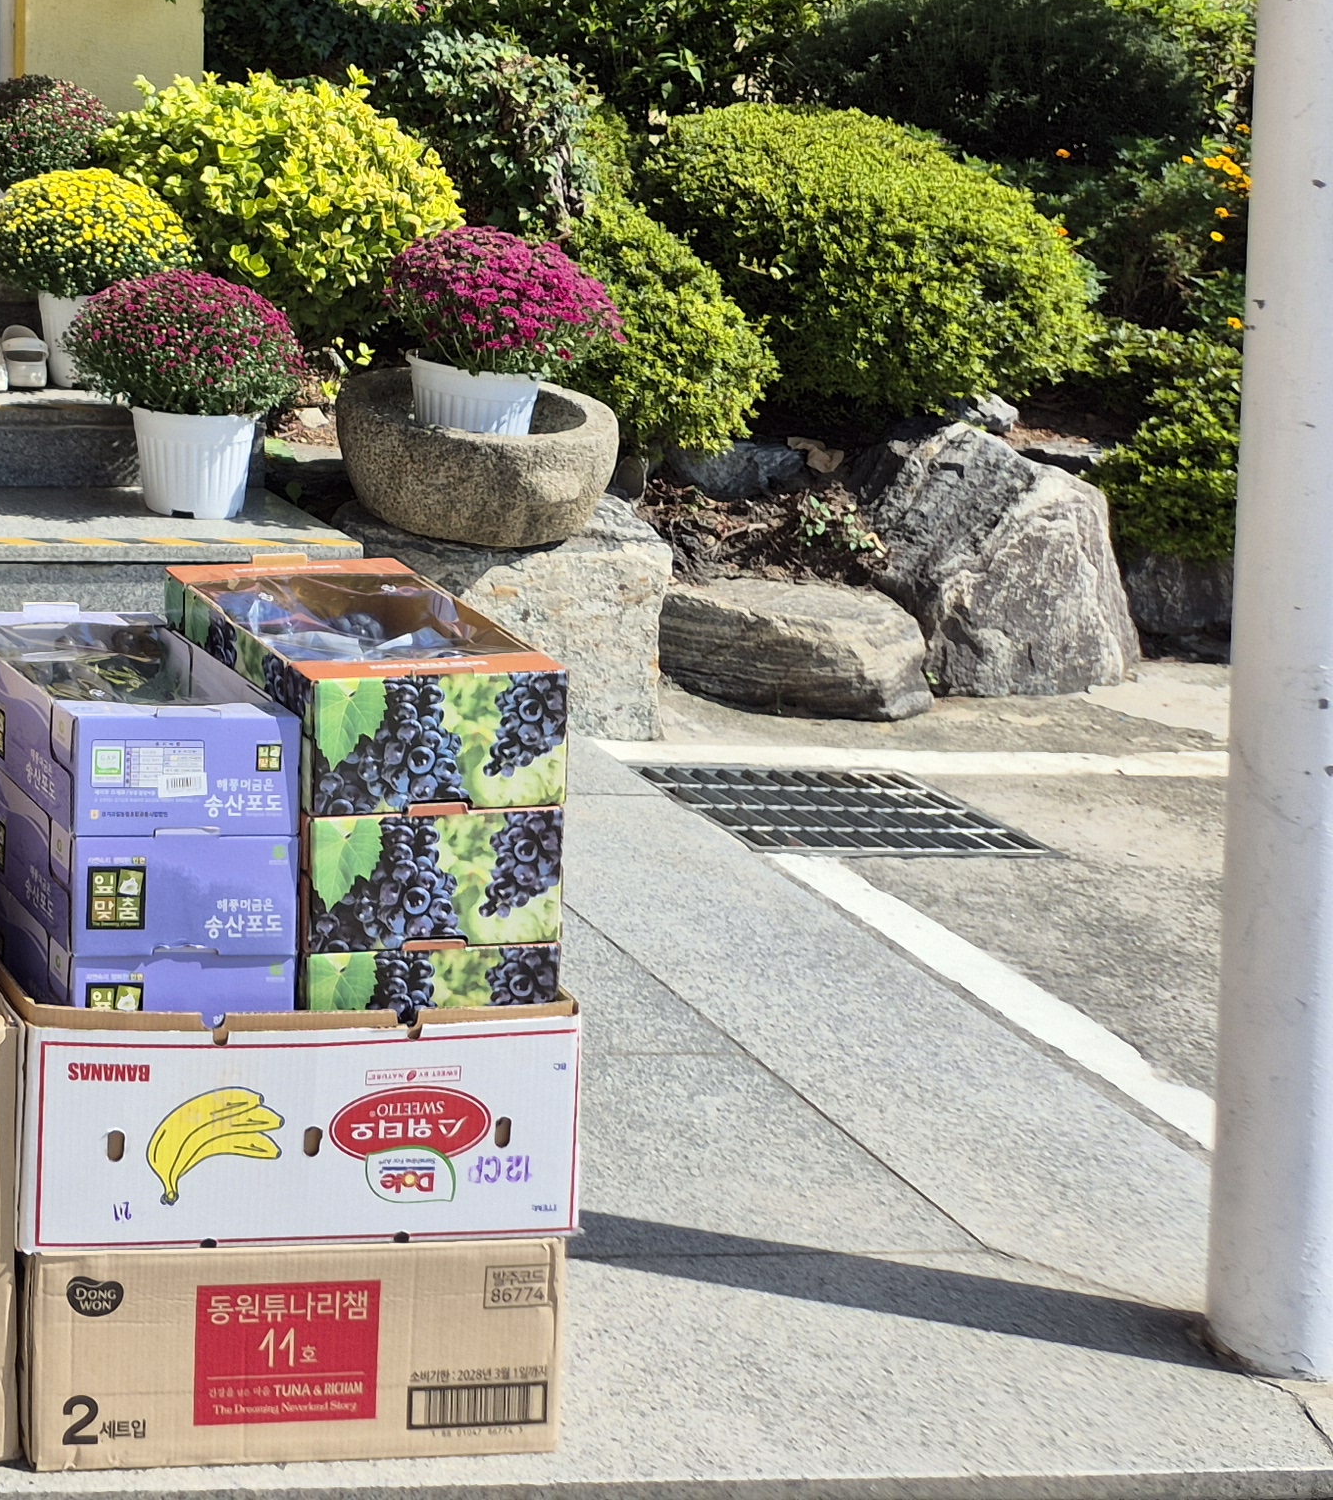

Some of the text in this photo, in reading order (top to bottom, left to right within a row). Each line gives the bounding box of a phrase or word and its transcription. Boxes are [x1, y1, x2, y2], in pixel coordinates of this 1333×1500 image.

[216, 778, 274, 792] 해풍머금은
[204, 794, 282, 818] 송산포도
[94, 873, 115, 894] 잎
[94, 897, 139, 920] 맞춤
[216, 898, 274, 912] 해풍머금은
[204, 914, 283, 939] 송산포도
[68, 1062, 151, 1083] BANANAS
[376, 1100, 445, 1117] SWEETIO
[350, 1116, 468, 1141] 스위티오
[380, 1171, 436, 1194] Dole
[492, 1270, 545, 1286] 발주코드
[74, 1285, 117, 1302] DONG
[491, 1287, 544, 1303] 86774
[79, 1298, 112, 1312] WON
[207, 1289, 368, 1325] 동원튜나리챔
[410, 1365, 548, 1382] 소비기한 2028년 3월 1일까지
[273, 1384, 310, 1397] TUNA
[313, 1385, 322, 1396] &
[324, 1381, 364, 1396] RICHAM
[213, 1404, 232, 1415] The
[329, 1399, 357, 1412] Story
